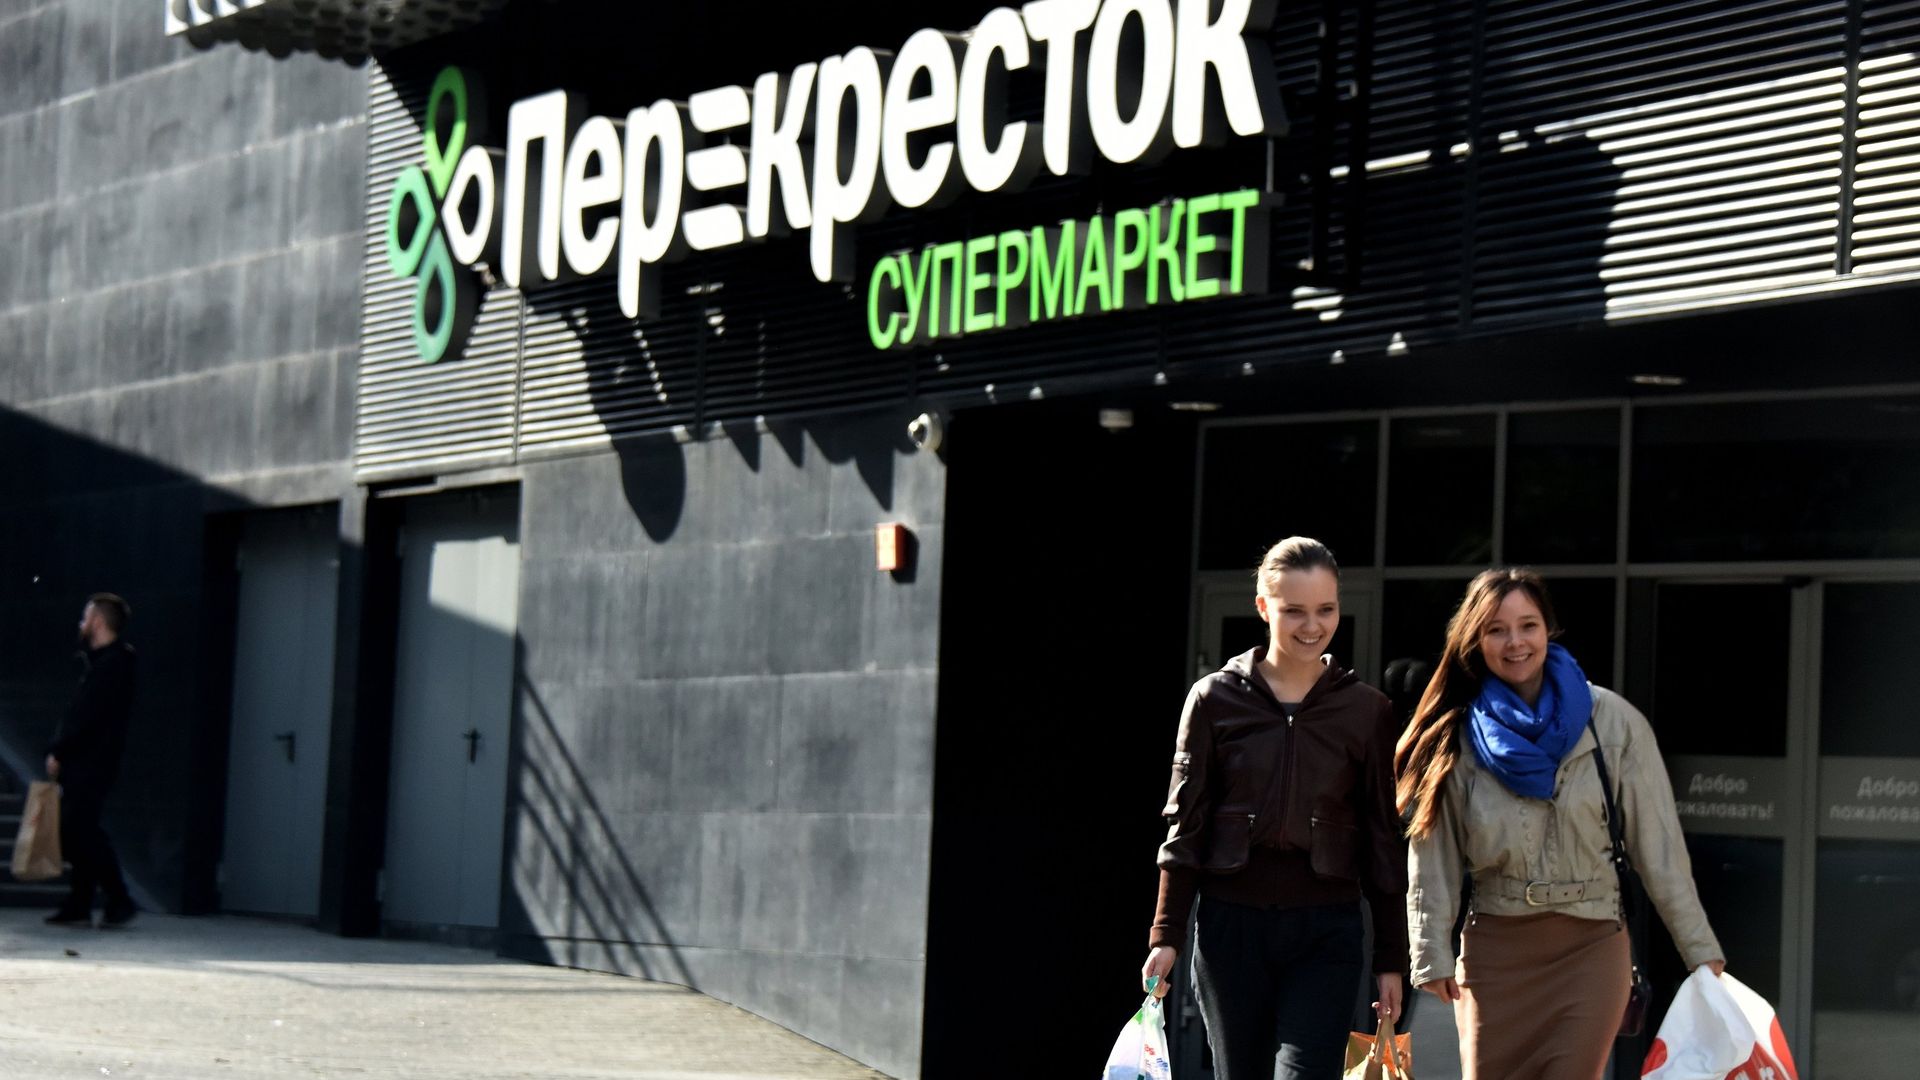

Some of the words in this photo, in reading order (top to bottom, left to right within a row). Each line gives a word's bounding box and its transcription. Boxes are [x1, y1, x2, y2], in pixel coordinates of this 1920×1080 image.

[868, 189, 1259, 349] СУПЕРМАРКЕТ
[1689, 773, 1748, 795] Добро
[1857, 776, 1919, 799] Добро
[1676, 801, 1774, 820] ожаловать!
